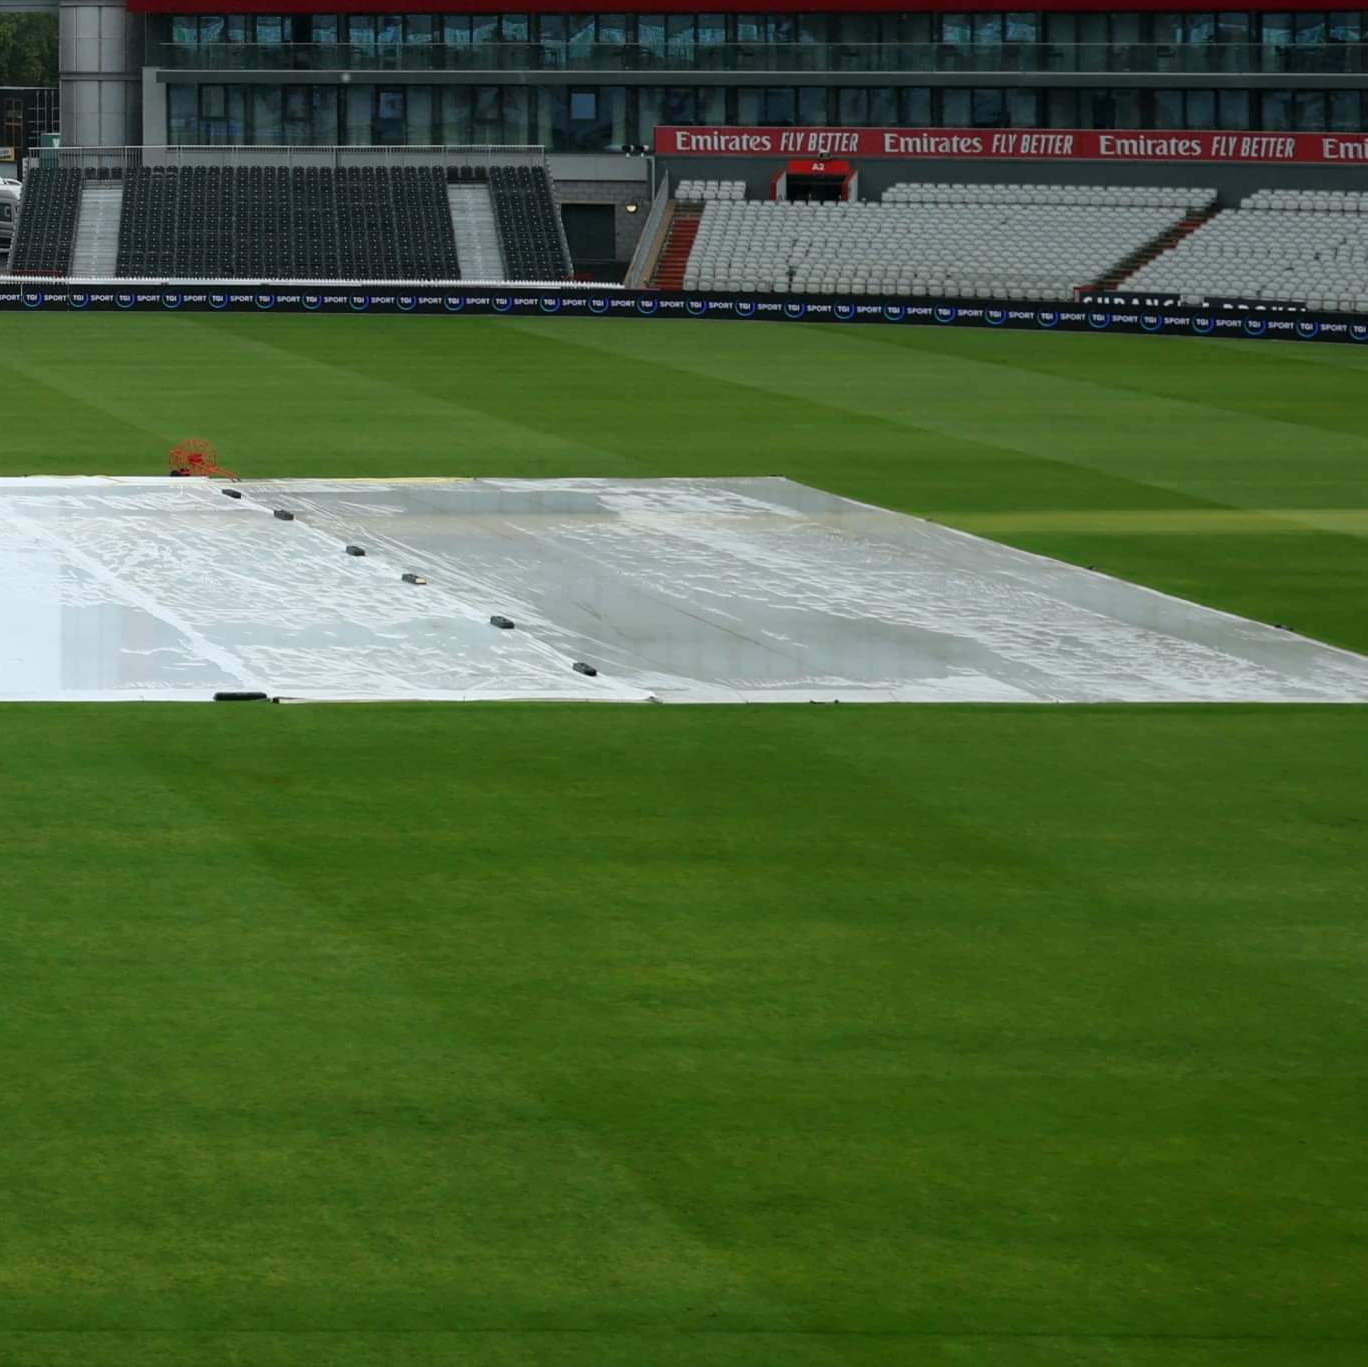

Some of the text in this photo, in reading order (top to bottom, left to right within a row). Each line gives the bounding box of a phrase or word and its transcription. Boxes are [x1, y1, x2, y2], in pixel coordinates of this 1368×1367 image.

[675, 131, 859, 152] Emirates FLY BETTER
[884, 132, 1074, 155] Emirates FLY BETTER
[1099, 135, 1295, 158] Emirates FLY BETTER
[811, 162, 825, 171] A2
[276, 295, 300, 303] SPORT
[466, 297, 490, 305] SPORT
[757, 303, 782, 311] SPORT
[907, 307, 933, 315] SPORT
[957, 309, 983, 317] SPORT
[1008, 311, 1034, 319] SPORT
[1060, 313, 1086, 321] SPORT
[1164, 317, 1190, 325] SPORT
[1216, 319, 1242, 327] SPORT
[1268, 321, 1294, 329] SPORT
[1320, 323, 1347, 331] SPORT
